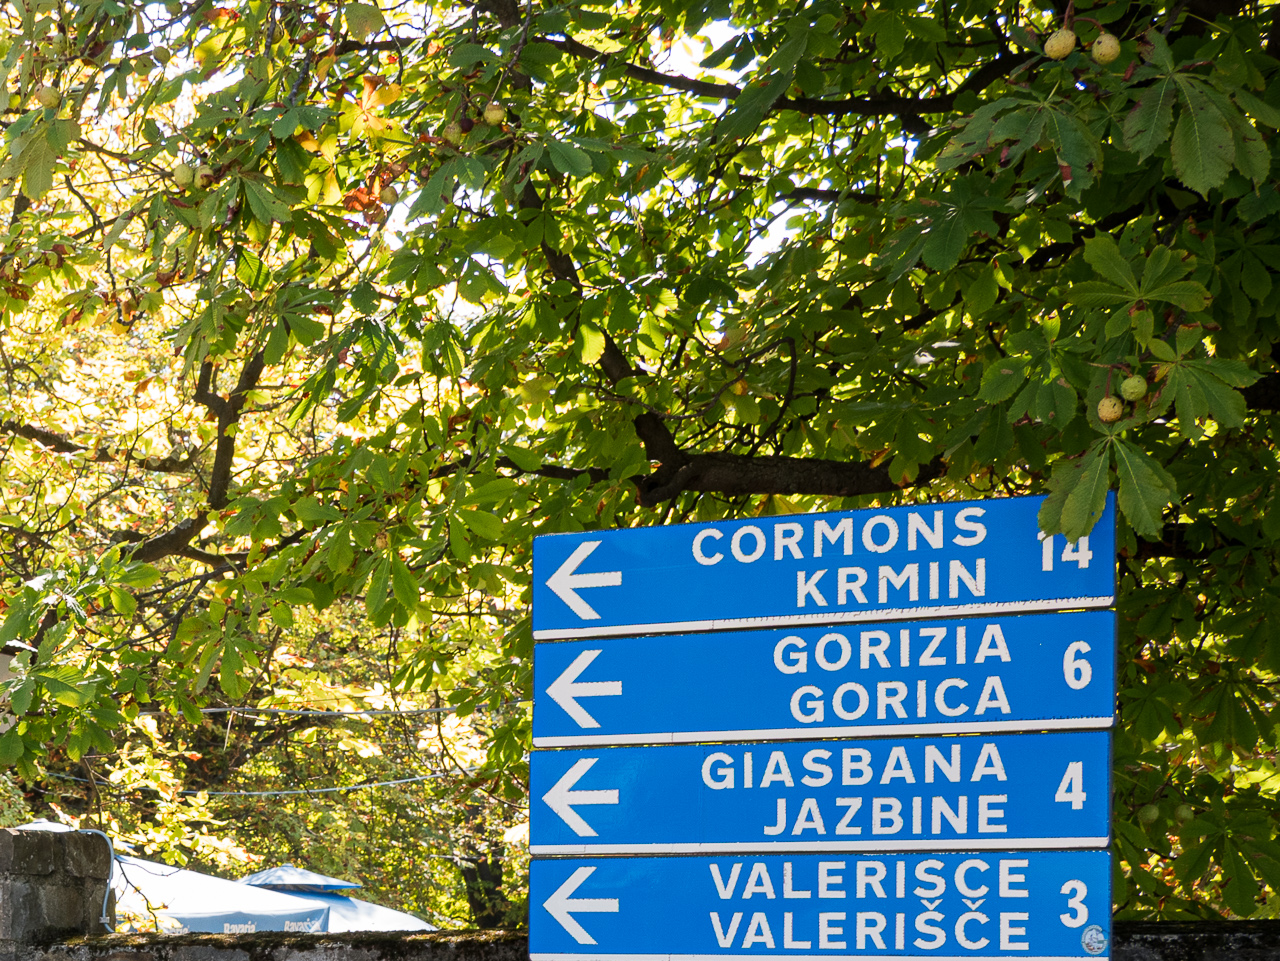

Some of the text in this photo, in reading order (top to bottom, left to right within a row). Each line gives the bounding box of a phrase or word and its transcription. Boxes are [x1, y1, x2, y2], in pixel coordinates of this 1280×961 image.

[692, 507, 1093, 571] CORMONS 14
[797, 557, 986, 608] KRMIN
[773, 624, 1092, 689] GORIZIA 6
[789, 676, 1011, 724] GORICA
[701, 743, 1086, 809] GIASBANA 4
[764, 794, 1007, 835] JAZBINE
[710, 859, 1089, 928] VALERISCE 3
[224, 921, 257, 934] Bavaria
[710, 898, 1029, 951] VALERIŠČE
